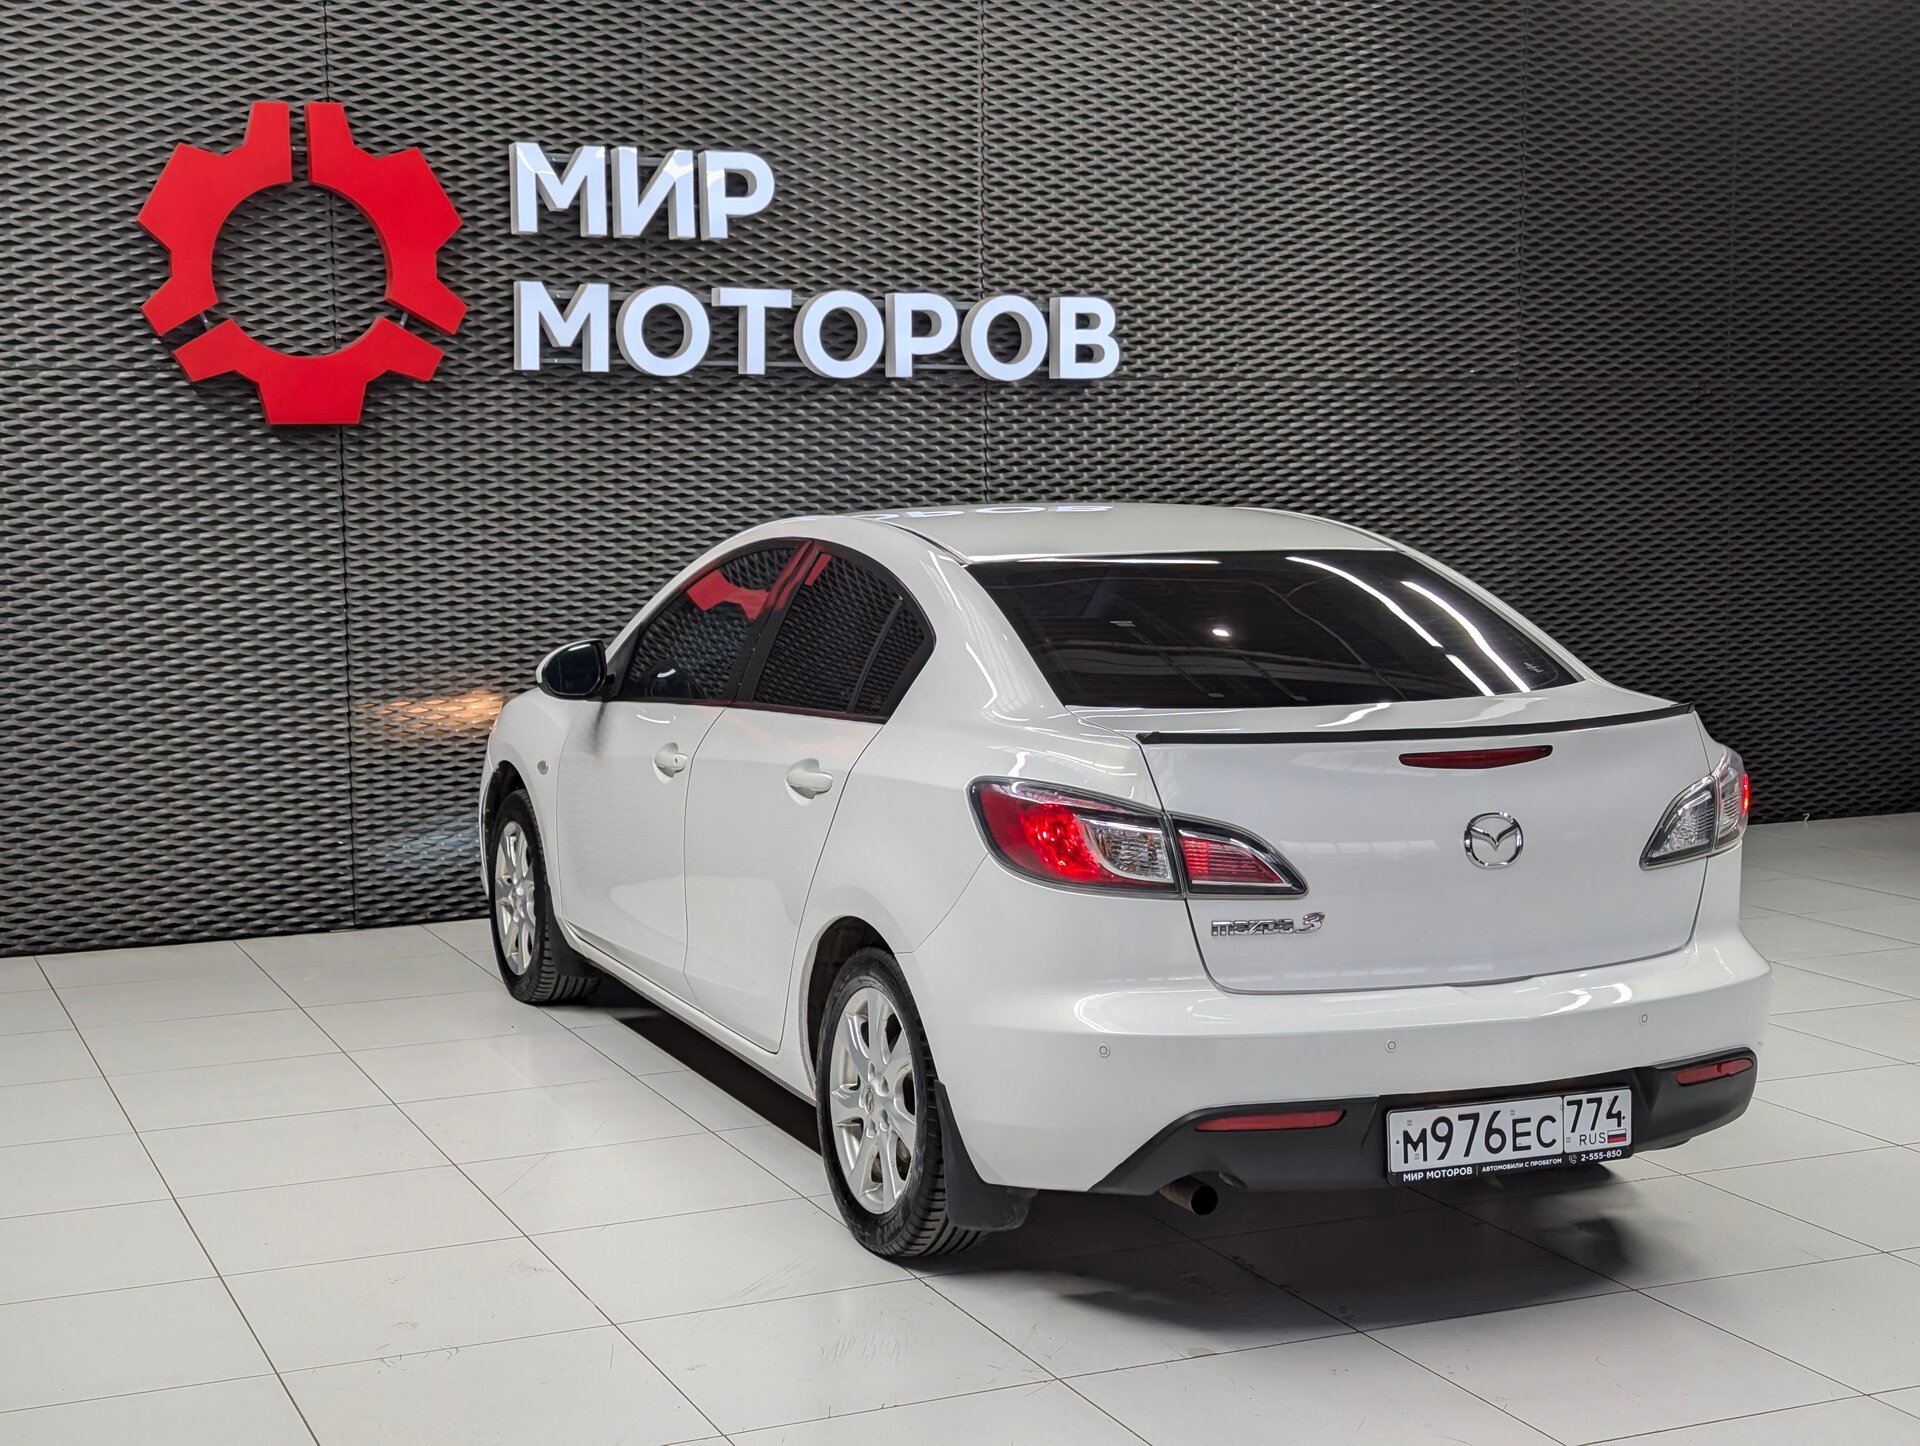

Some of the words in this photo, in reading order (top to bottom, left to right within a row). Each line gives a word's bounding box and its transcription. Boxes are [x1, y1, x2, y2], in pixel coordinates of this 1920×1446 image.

[509, 141, 776, 241] МИР
[513, 280, 1121, 382] МОТОРОВ
[1295, 912, 1325, 934] 3
[1566, 1095, 1623, 1133] 774
[1579, 1131, 1606, 1147] RUS
[1403, 1170, 1424, 1182] МИР
[1426, 1166, 1473, 1179] МОТОРОВ
[1481, 1163, 1523, 1173] АВТОМОБИЛИ
[1530, 1157, 1562, 1168] ПРОБЕГОМ
[1581, 1149, 1622, 1162] 2-555-850
